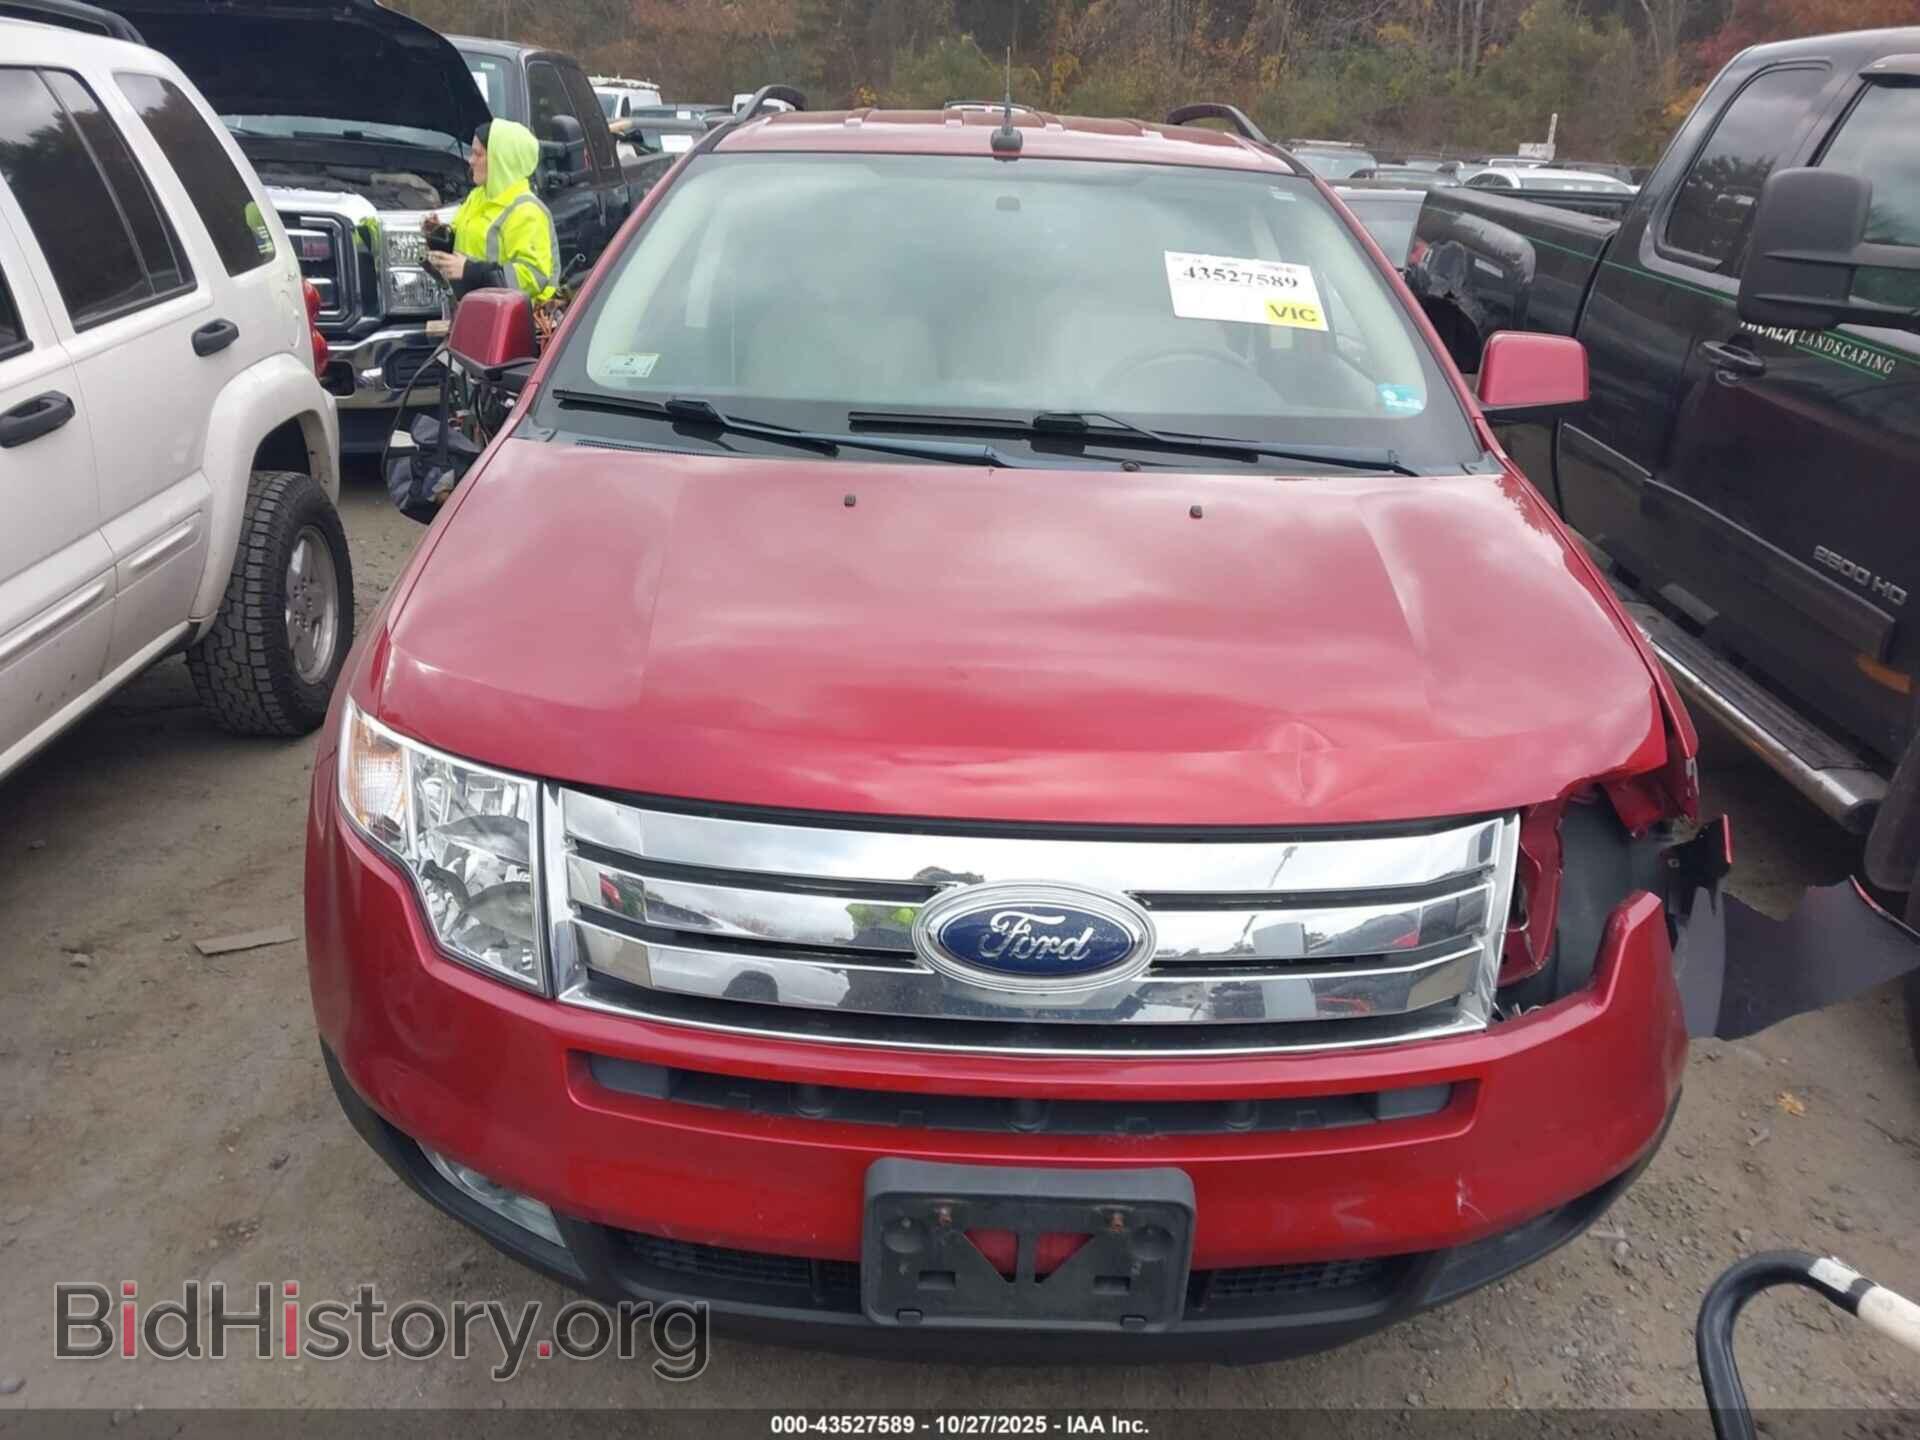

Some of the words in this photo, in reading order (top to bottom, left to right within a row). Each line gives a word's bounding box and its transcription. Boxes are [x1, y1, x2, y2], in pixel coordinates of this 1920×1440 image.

[1183, 266, 1298, 288] 43527589
[1269, 304, 1317, 322] VIC
[1799, 330, 1897, 375] LANDSCAPING
[1871, 576, 1908, 606] HD
[979, 910, 1095, 961] Ford
